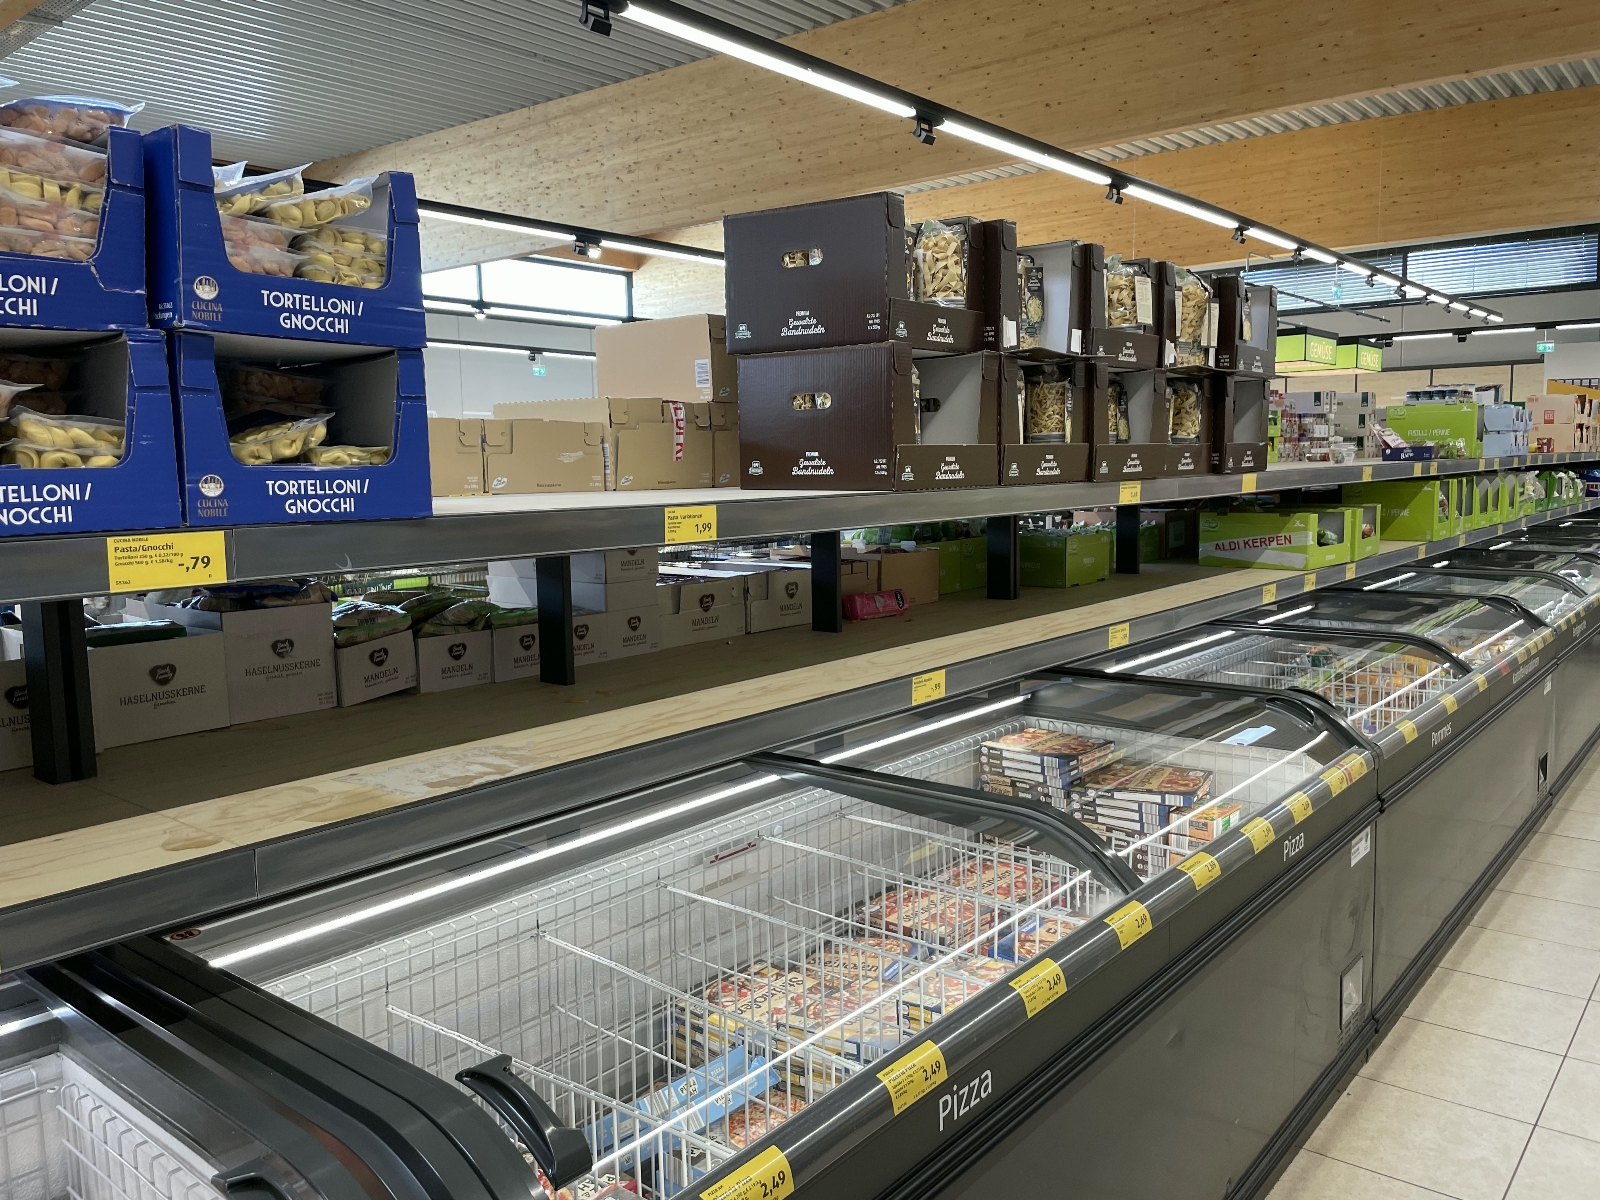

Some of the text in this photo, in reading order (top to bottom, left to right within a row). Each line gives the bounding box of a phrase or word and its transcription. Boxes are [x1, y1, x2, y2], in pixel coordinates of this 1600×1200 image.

[191, 300, 223, 312] CUCINA
[261, 289, 355, 316] TORTELLONI
[191, 310, 223, 322] NOBILE
[279, 312, 349, 334] GNOCCHI
[780, 324, 826, 337] Bandnudeln
[1310, 341, 1333, 360] GEMÜSE
[1360, 351, 1379, 368] GEMÜSE
[265, 479, 361, 496] TORTELLONI
[197, 498, 229, 508] CUCINA
[285, 497, 355, 514] GNOCCHI
[197, 508, 229, 518] NOBILE
[694, 522, 712, 535] 1,99
[114, 542, 174, 553] Pasta/Gnocchi
[1214, 534, 1293, 552] ALDI KERPEN
[178, 555, 211, 573] -,79
[620, 558, 645, 567] MANDELN
[691, 614, 720, 627] MANDELN
[622, 633, 647, 644] MANDELN
[244, 658, 322, 677] HASELNUSSKERNE
[363, 666, 399, 683] MANDELN
[441, 662, 474, 675] MANDELN
[119, 684, 207, 707] HASELNUSSKERNE
[1431, 721, 1452, 748] Pommes
[1283, 832, 1304, 862] Pizza
[1046, 973, 1062, 992] 2,49
[922, 1060, 941, 1082] 2,49
[939, 1069, 992, 1132] Pizza
[760, 1170, 786, 1199] 2,49
